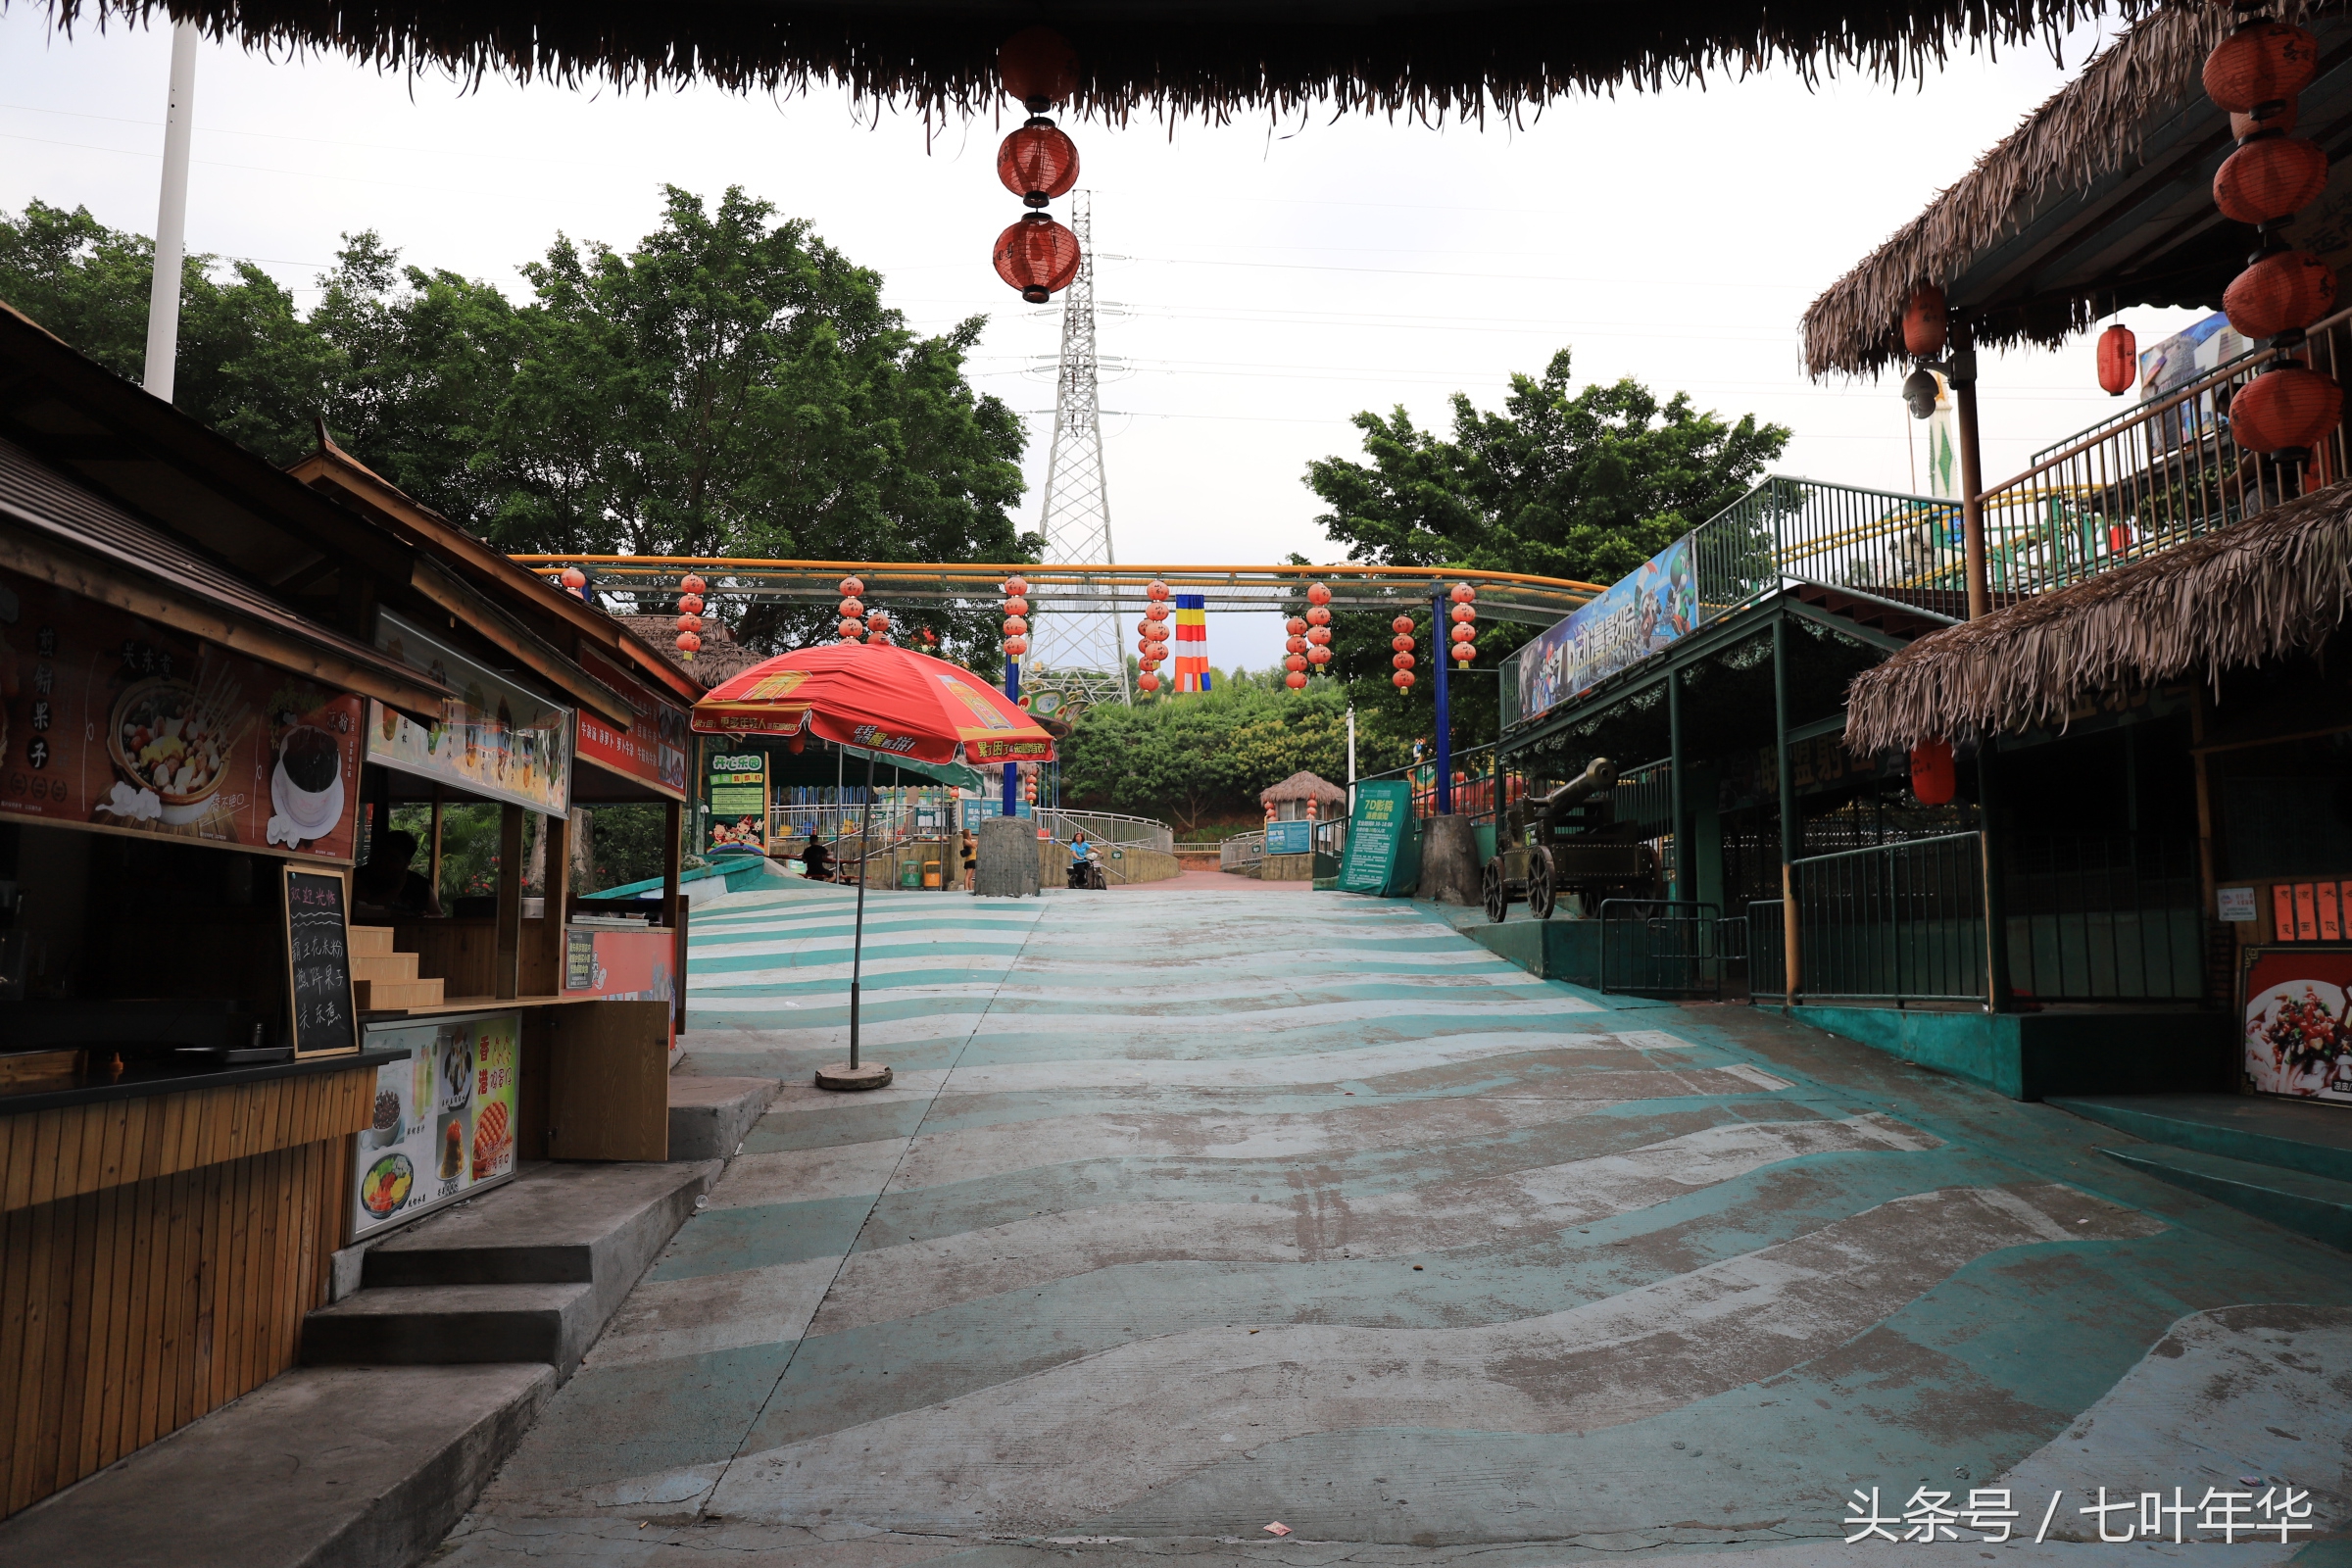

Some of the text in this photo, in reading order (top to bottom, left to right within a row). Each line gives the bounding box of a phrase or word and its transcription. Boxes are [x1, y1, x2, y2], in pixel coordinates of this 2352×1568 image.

[713, 756, 761, 770] 开心乐园
[1364, 800, 1394, 812] 7D影院
[290, 886, 336, 906] 欢迎光临
[292, 935, 343, 963] 霸王花米粉
[478, 1035, 489, 1095] 香港
